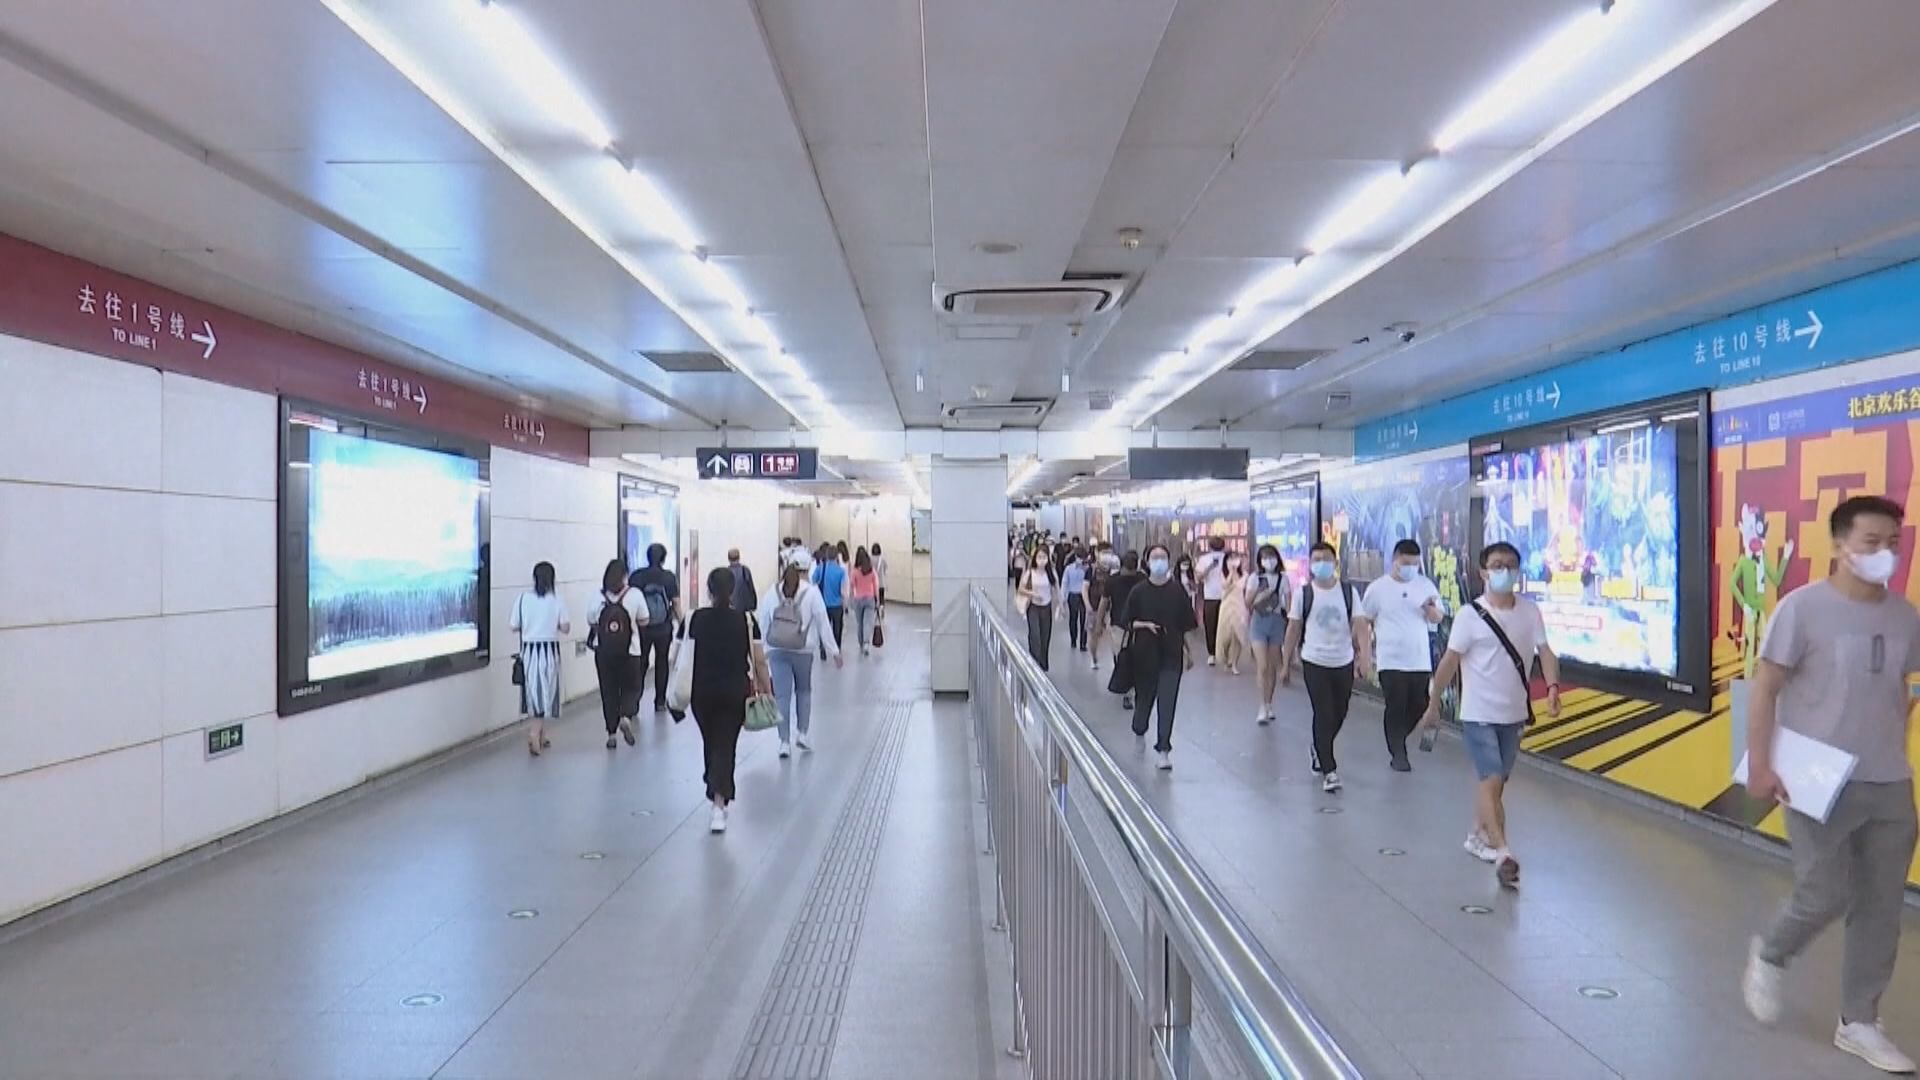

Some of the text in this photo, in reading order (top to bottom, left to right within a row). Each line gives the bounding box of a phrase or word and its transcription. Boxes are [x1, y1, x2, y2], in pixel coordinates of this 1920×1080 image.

[78, 284, 185, 340] 去往1号线
[112, 327, 157, 350] TO LINE 1
[1695, 318, 1792, 364] 去往10号线
[1732, 358, 1751, 372] LINE
[1848, 387, 1920, 418] 北京欢乐谷
